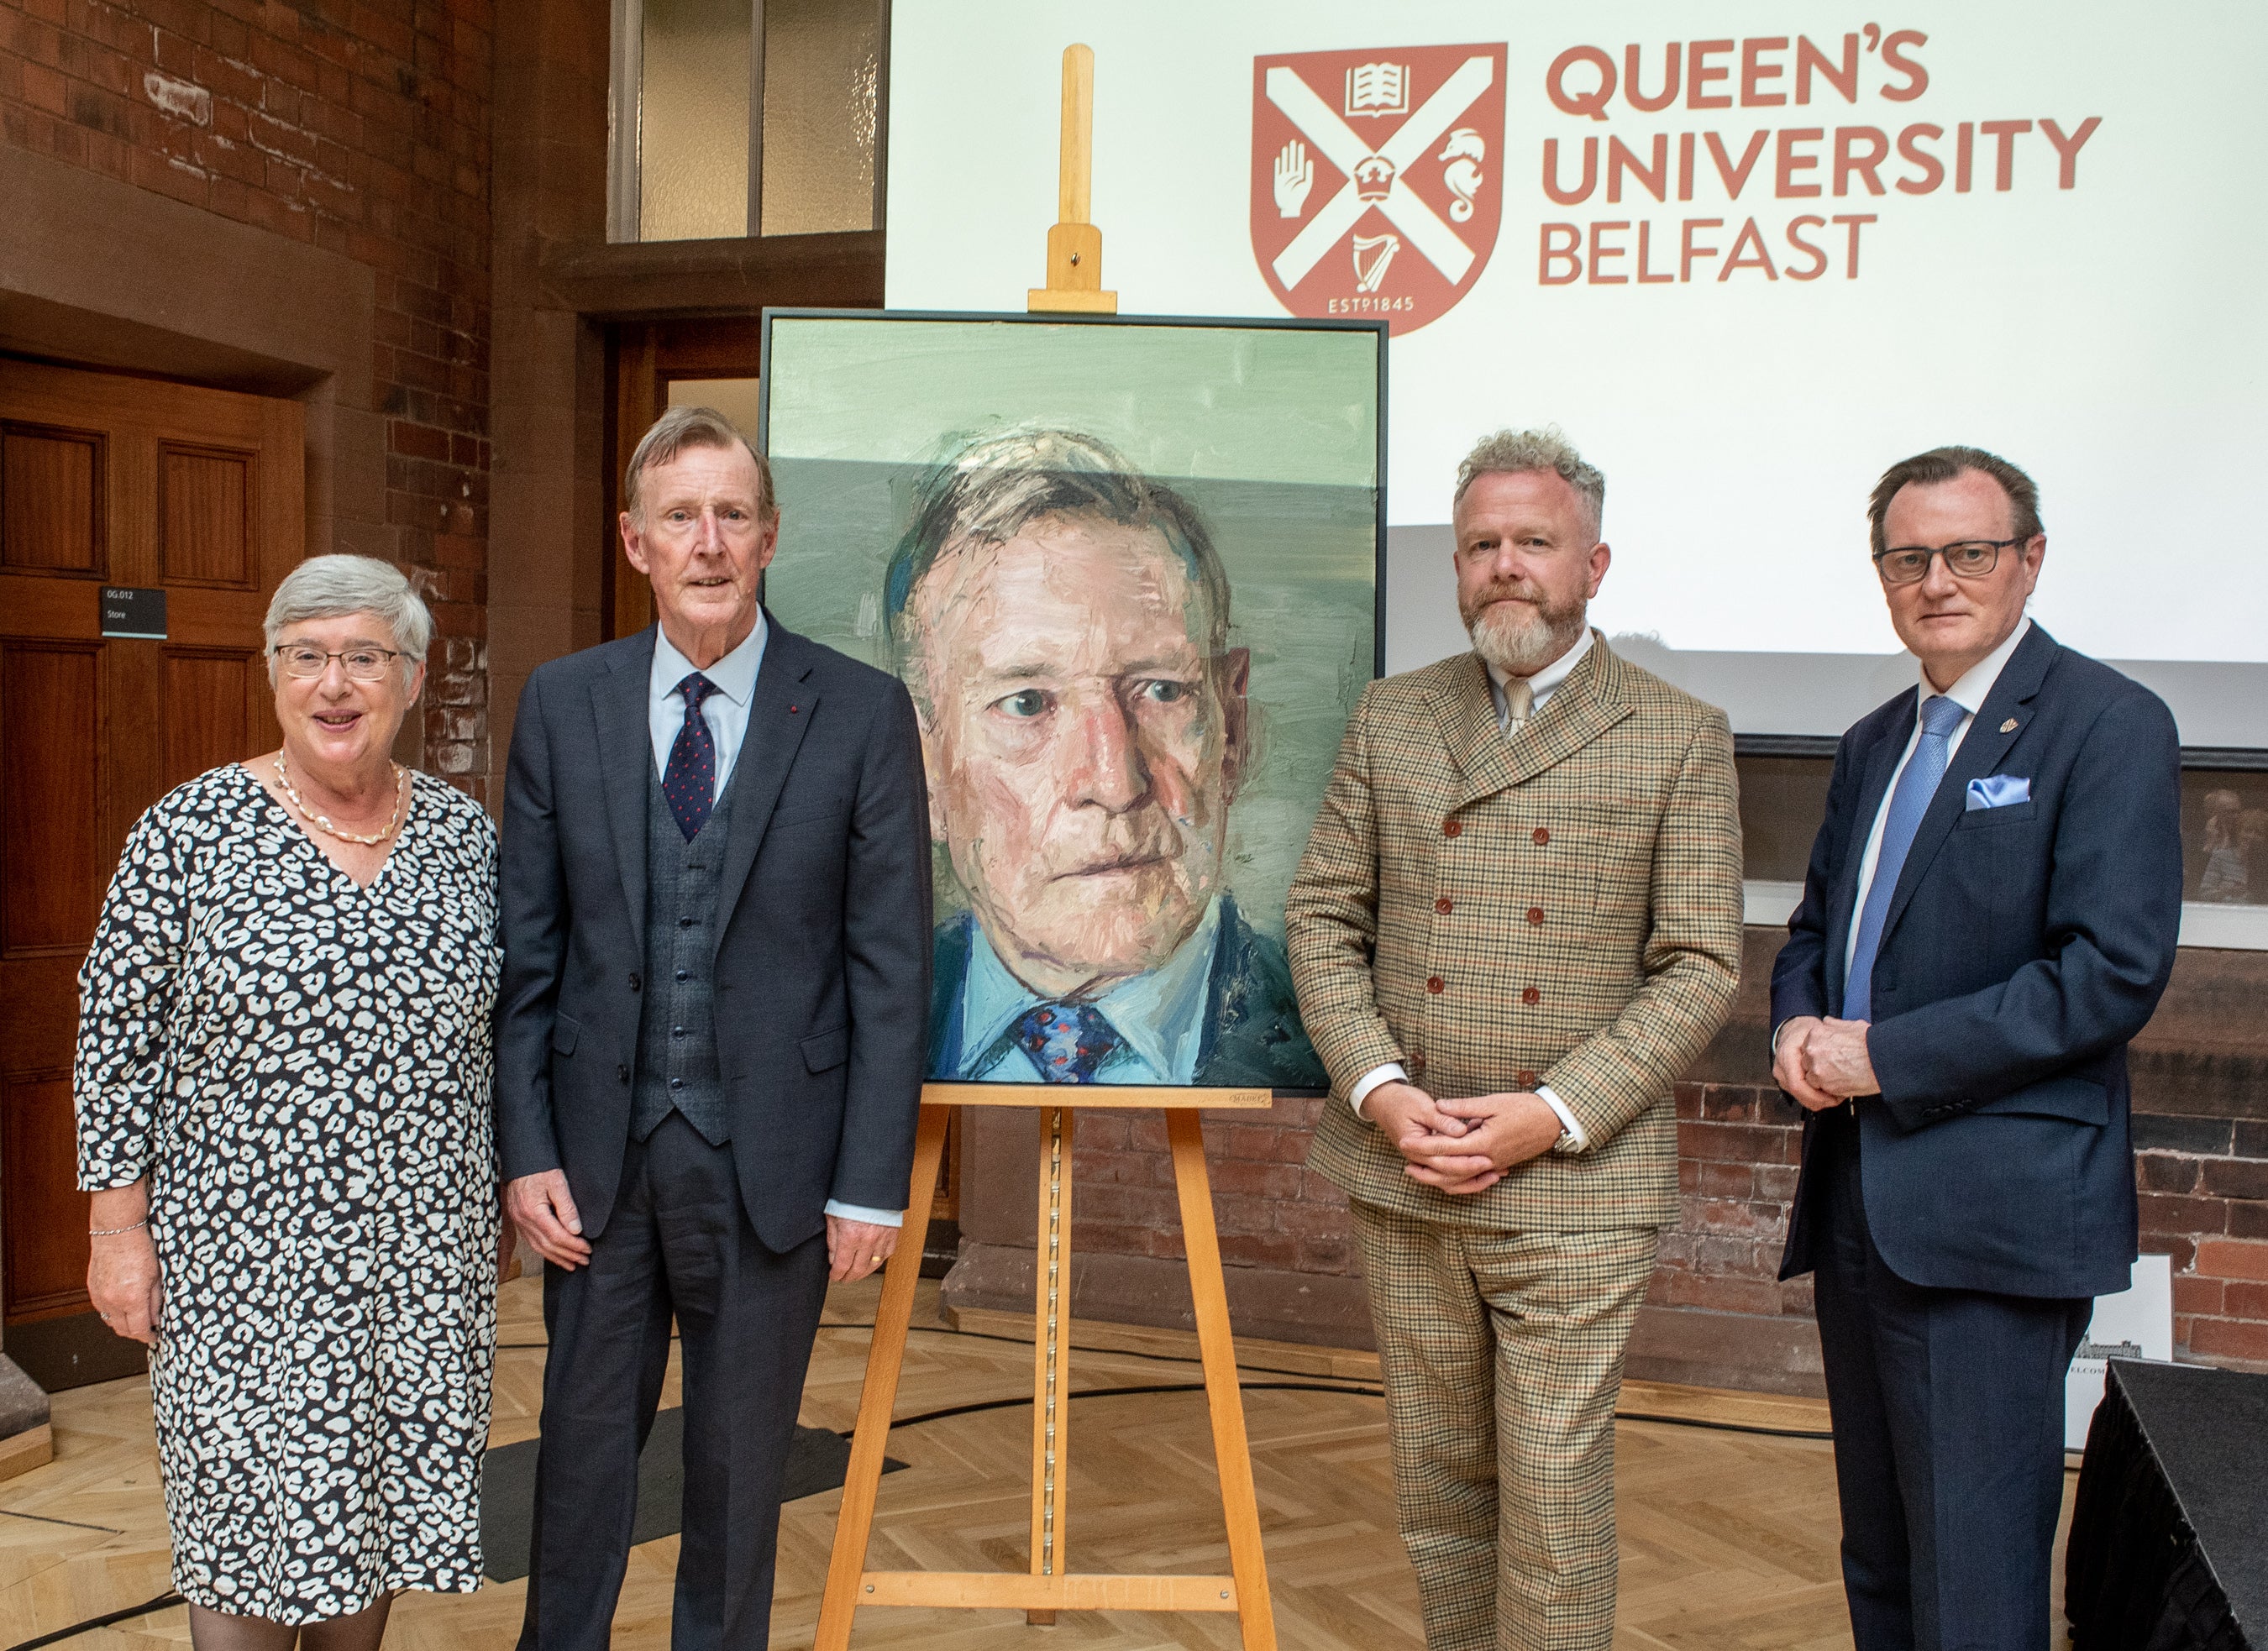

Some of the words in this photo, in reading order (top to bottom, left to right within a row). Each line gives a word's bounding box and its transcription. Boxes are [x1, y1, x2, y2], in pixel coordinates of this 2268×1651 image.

[1546, 23, 1929, 122] QUEEN’S
[1542, 117, 2102, 206] UNIVERSITY
[1539, 214, 1877, 286] BELFAST
[107, 610, 126, 619] Store
[2070, 1366, 2105, 1375] ELCOM
